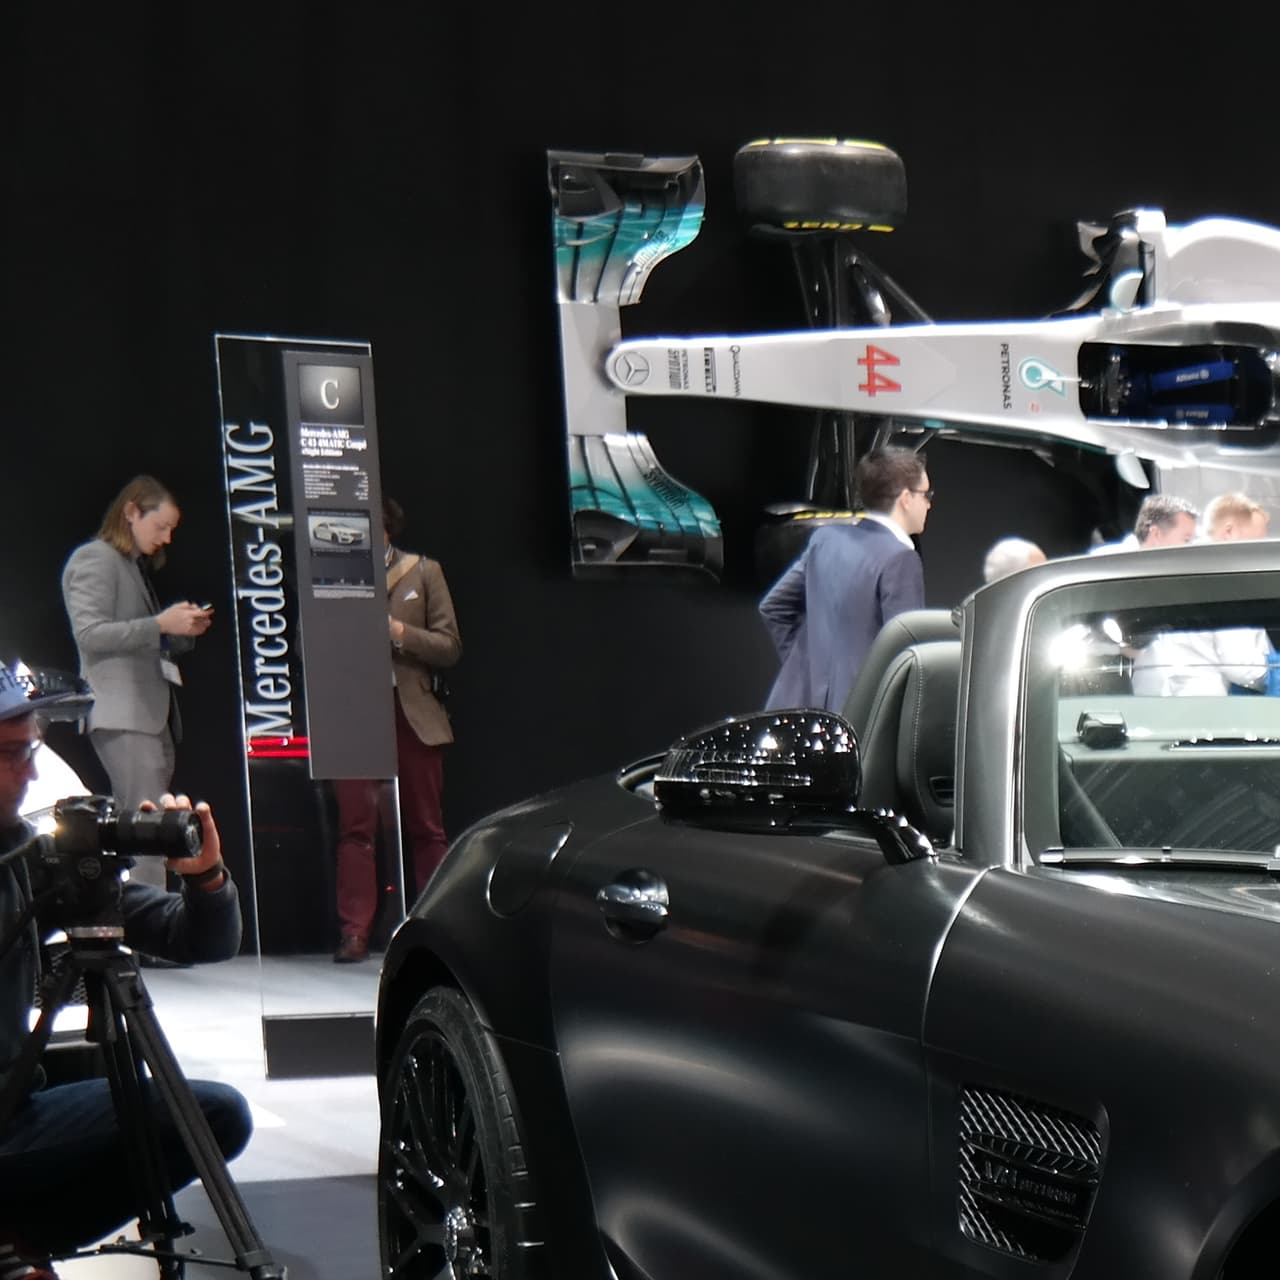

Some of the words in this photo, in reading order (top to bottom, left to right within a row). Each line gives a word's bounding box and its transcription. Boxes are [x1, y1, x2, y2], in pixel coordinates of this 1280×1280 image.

[320, 379, 340, 410] C
[856, 344, 902, 397] 44
[1000, 343, 1012, 410] PETRONAS
[224, 420, 295, 739] Mercedes-AMG
